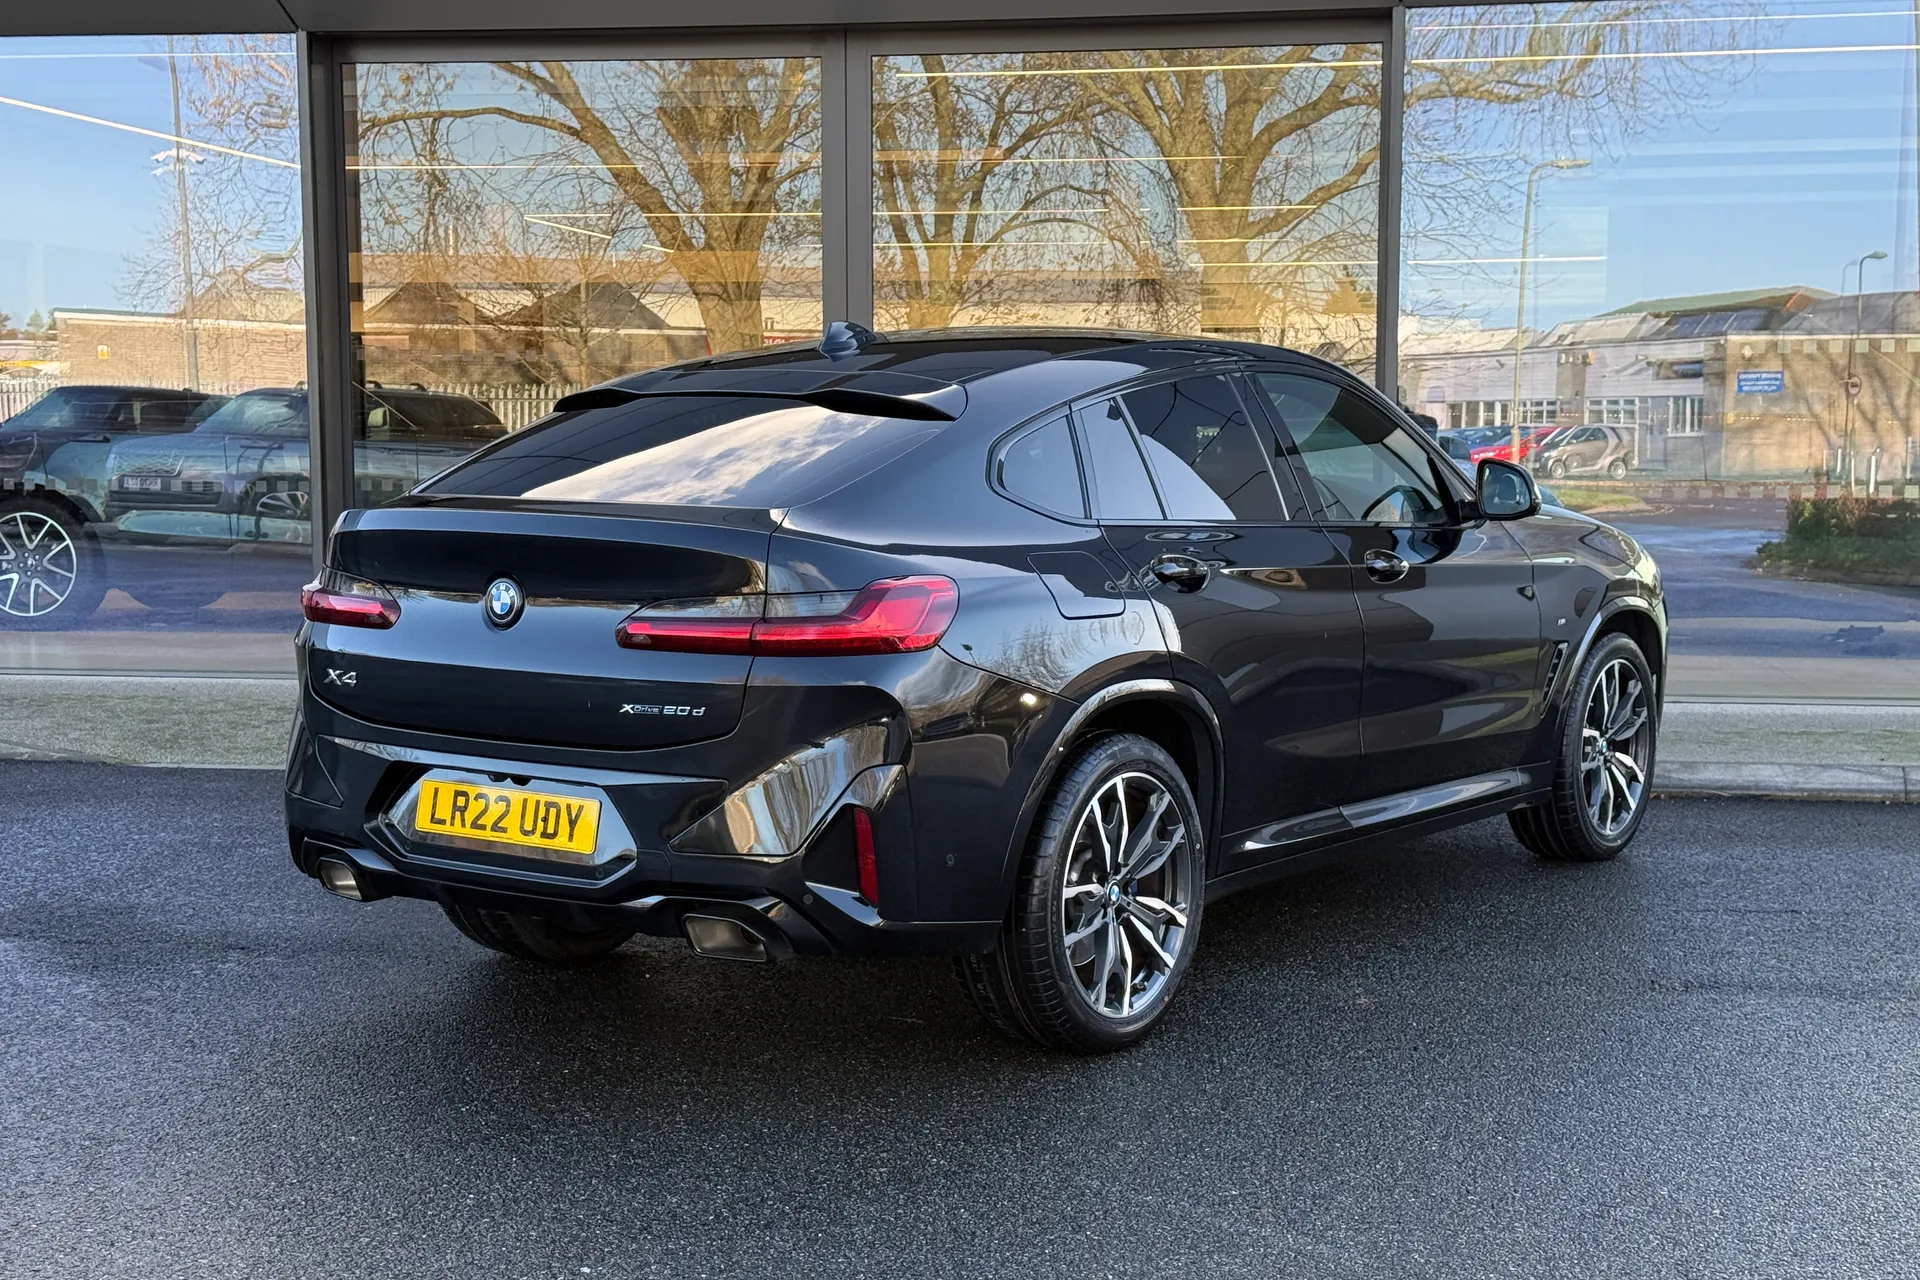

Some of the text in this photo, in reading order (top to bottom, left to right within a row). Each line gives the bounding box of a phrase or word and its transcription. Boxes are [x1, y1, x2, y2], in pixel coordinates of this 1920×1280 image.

[323, 668, 357, 687] X4
[429, 787, 584, 843] LR22 UDY
